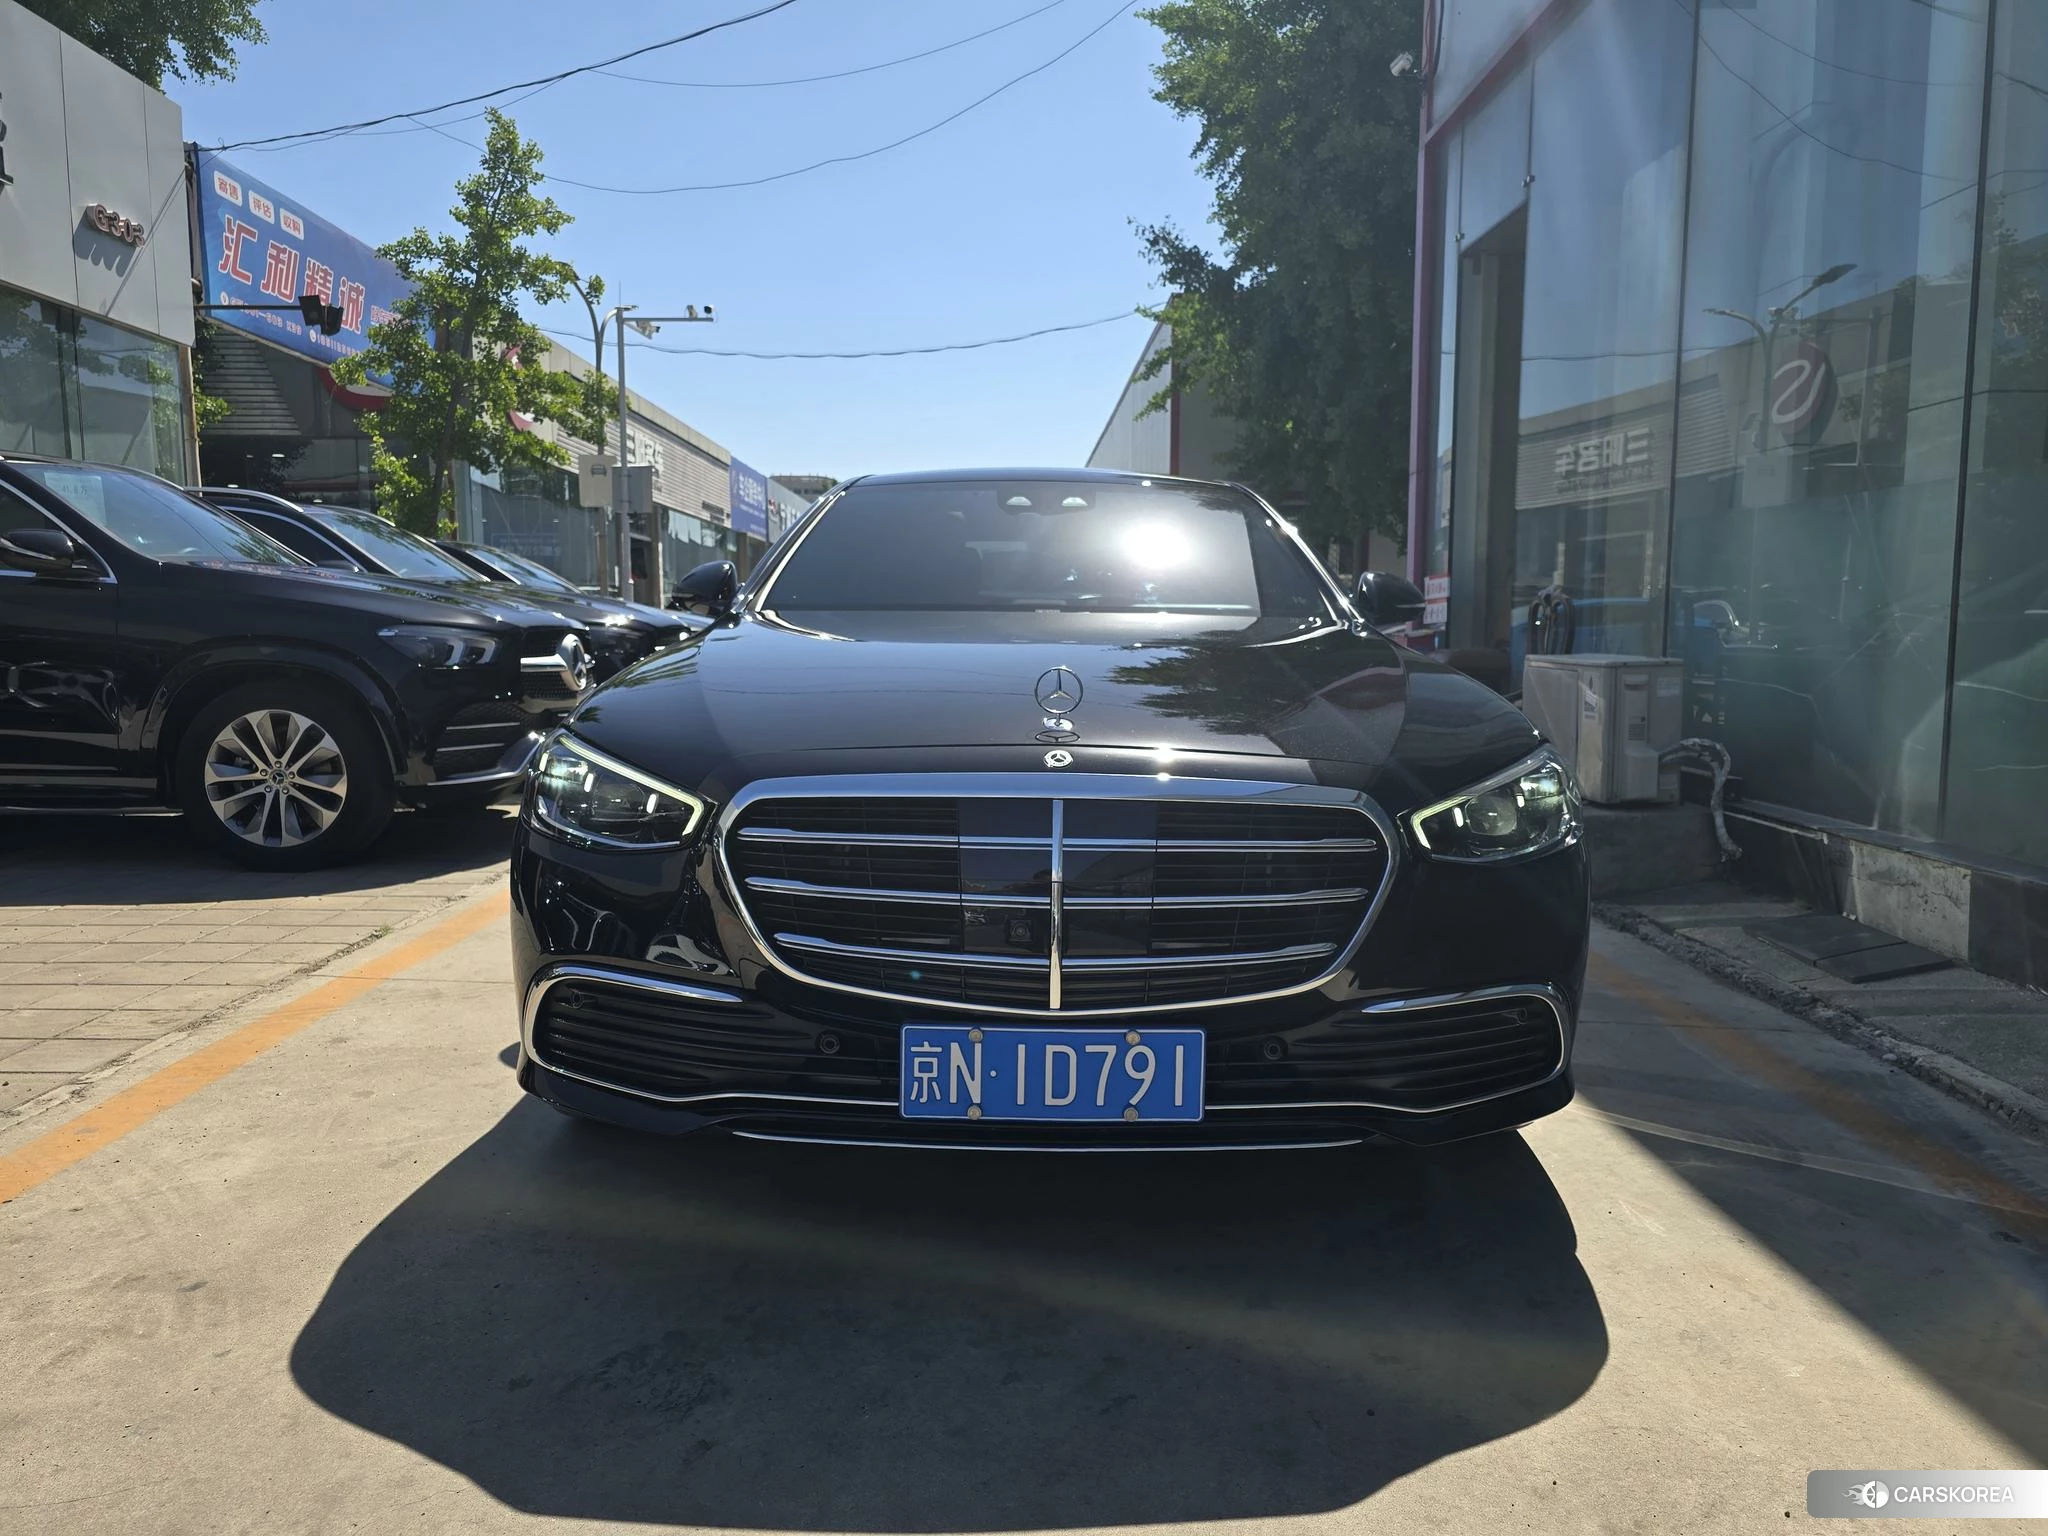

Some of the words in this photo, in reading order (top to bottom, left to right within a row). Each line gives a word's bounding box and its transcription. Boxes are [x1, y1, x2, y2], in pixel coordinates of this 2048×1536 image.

[216, 176, 239, 201] 寄售
[252, 196, 272, 219] 评估
[94, 203, 147, 247] G303
[283, 214, 301, 235] 收购
[218, 214, 365, 334] 汇利精诚
